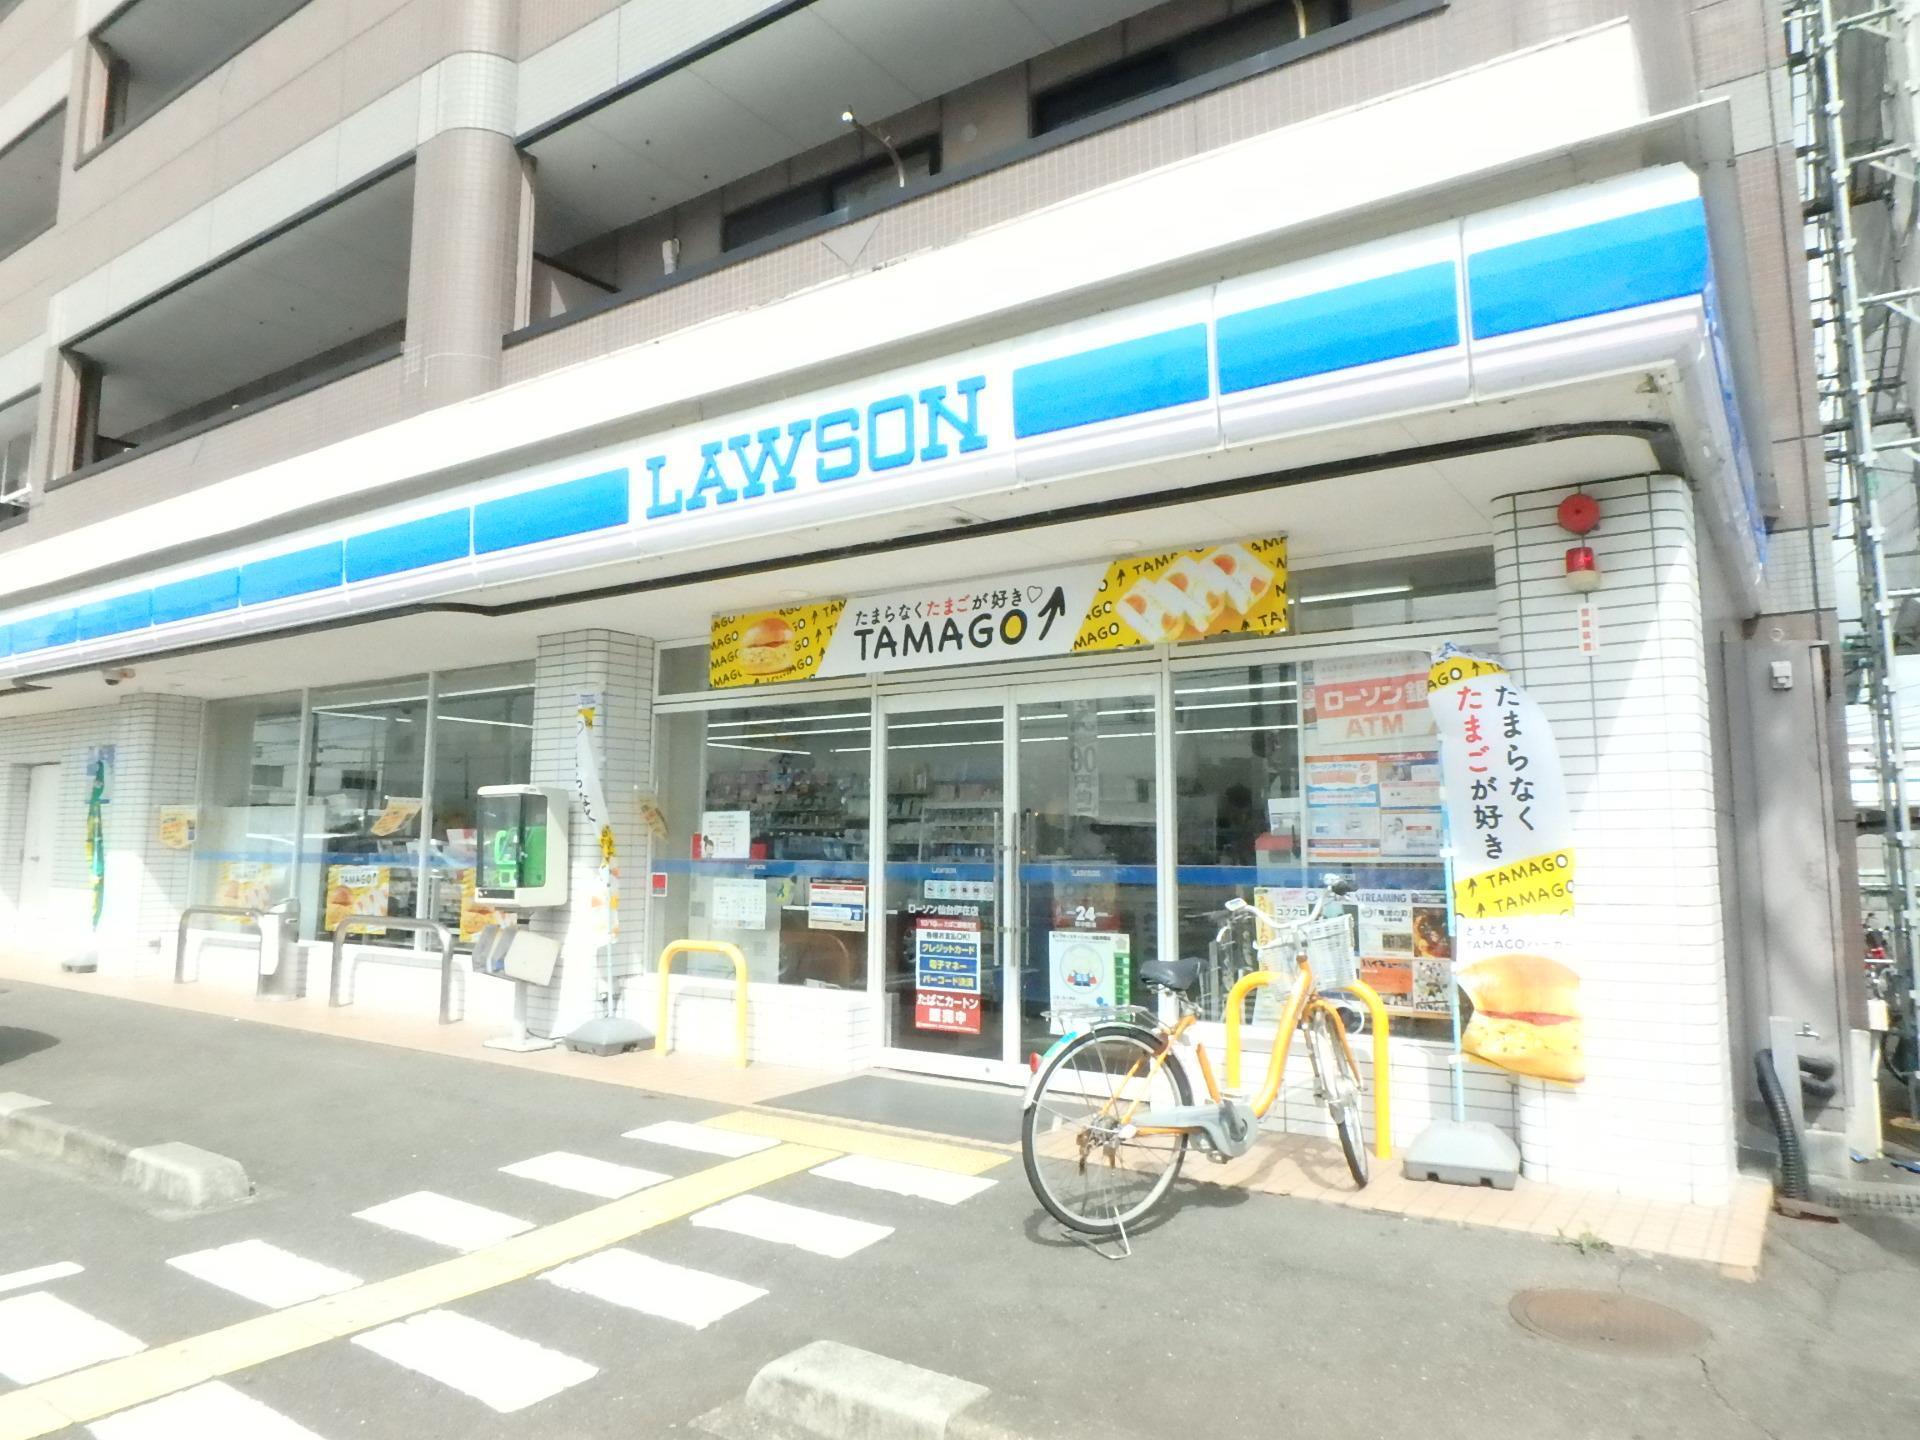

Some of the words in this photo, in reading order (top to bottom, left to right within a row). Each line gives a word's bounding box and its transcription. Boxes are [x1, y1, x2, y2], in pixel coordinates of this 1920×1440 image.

[646, 375, 988, 520] LAWSON
[855, 588, 1023, 627] たまらなくたまごが好き
[853, 608, 1028, 661] TAMAGO
[1345, 713, 1405, 738] ATM
[1457, 686, 1503, 860] たまごが好き
[1495, 685, 1535, 831] たまらなく
[1485, 853, 1568, 889] TAMAGO
[921, 943, 976, 956] クレジットカード
[916, 993, 979, 1010] たばこカートン
